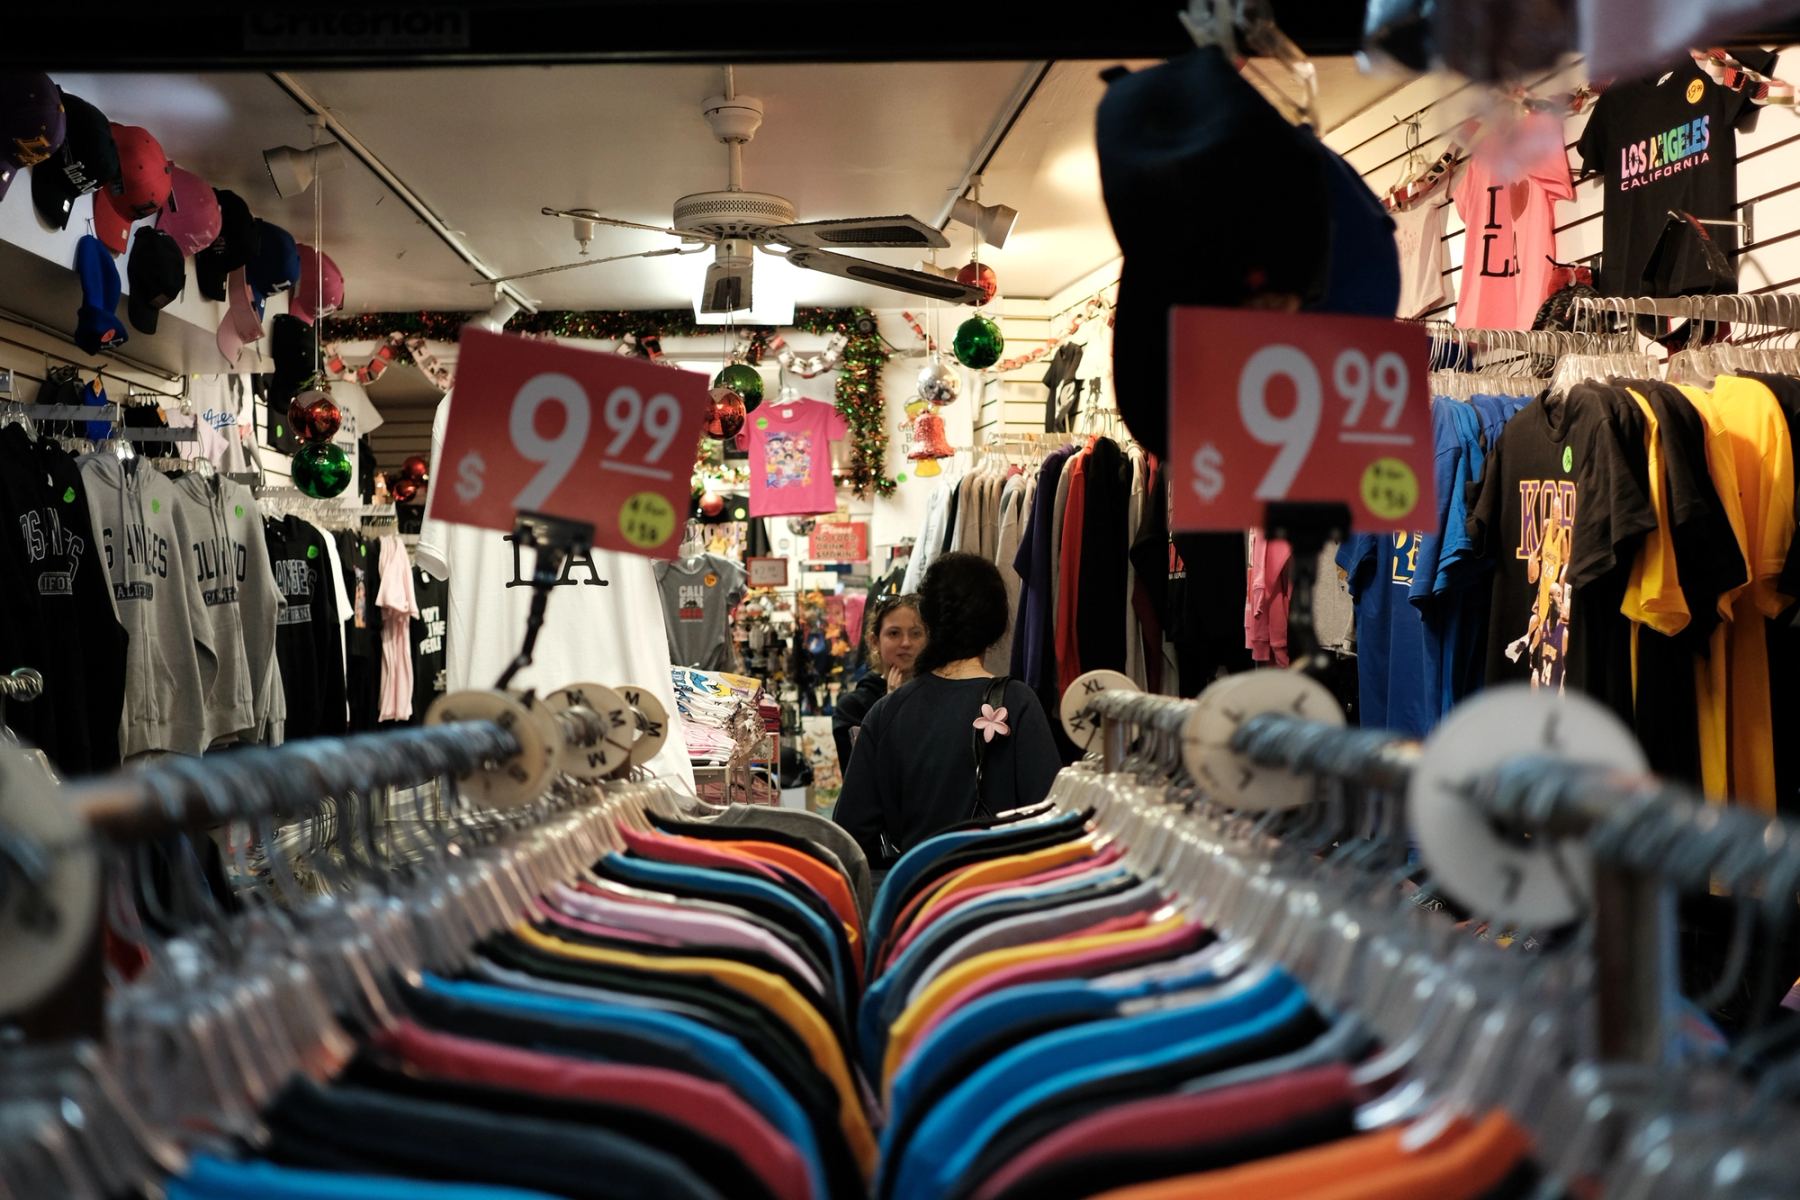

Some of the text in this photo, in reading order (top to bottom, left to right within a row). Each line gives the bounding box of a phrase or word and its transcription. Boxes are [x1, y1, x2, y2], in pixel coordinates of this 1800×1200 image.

[251, 10, 461, 36] Criterion
[1621, 115, 1710, 179] LOS ANGELES
[1621, 152, 1710, 191] CALIFORNIA
[1484, 185, 1504, 230] I
[1480, 231, 1520, 277] LA
[625, 691, 640, 705] M
[1082, 679, 1104, 695] XL
